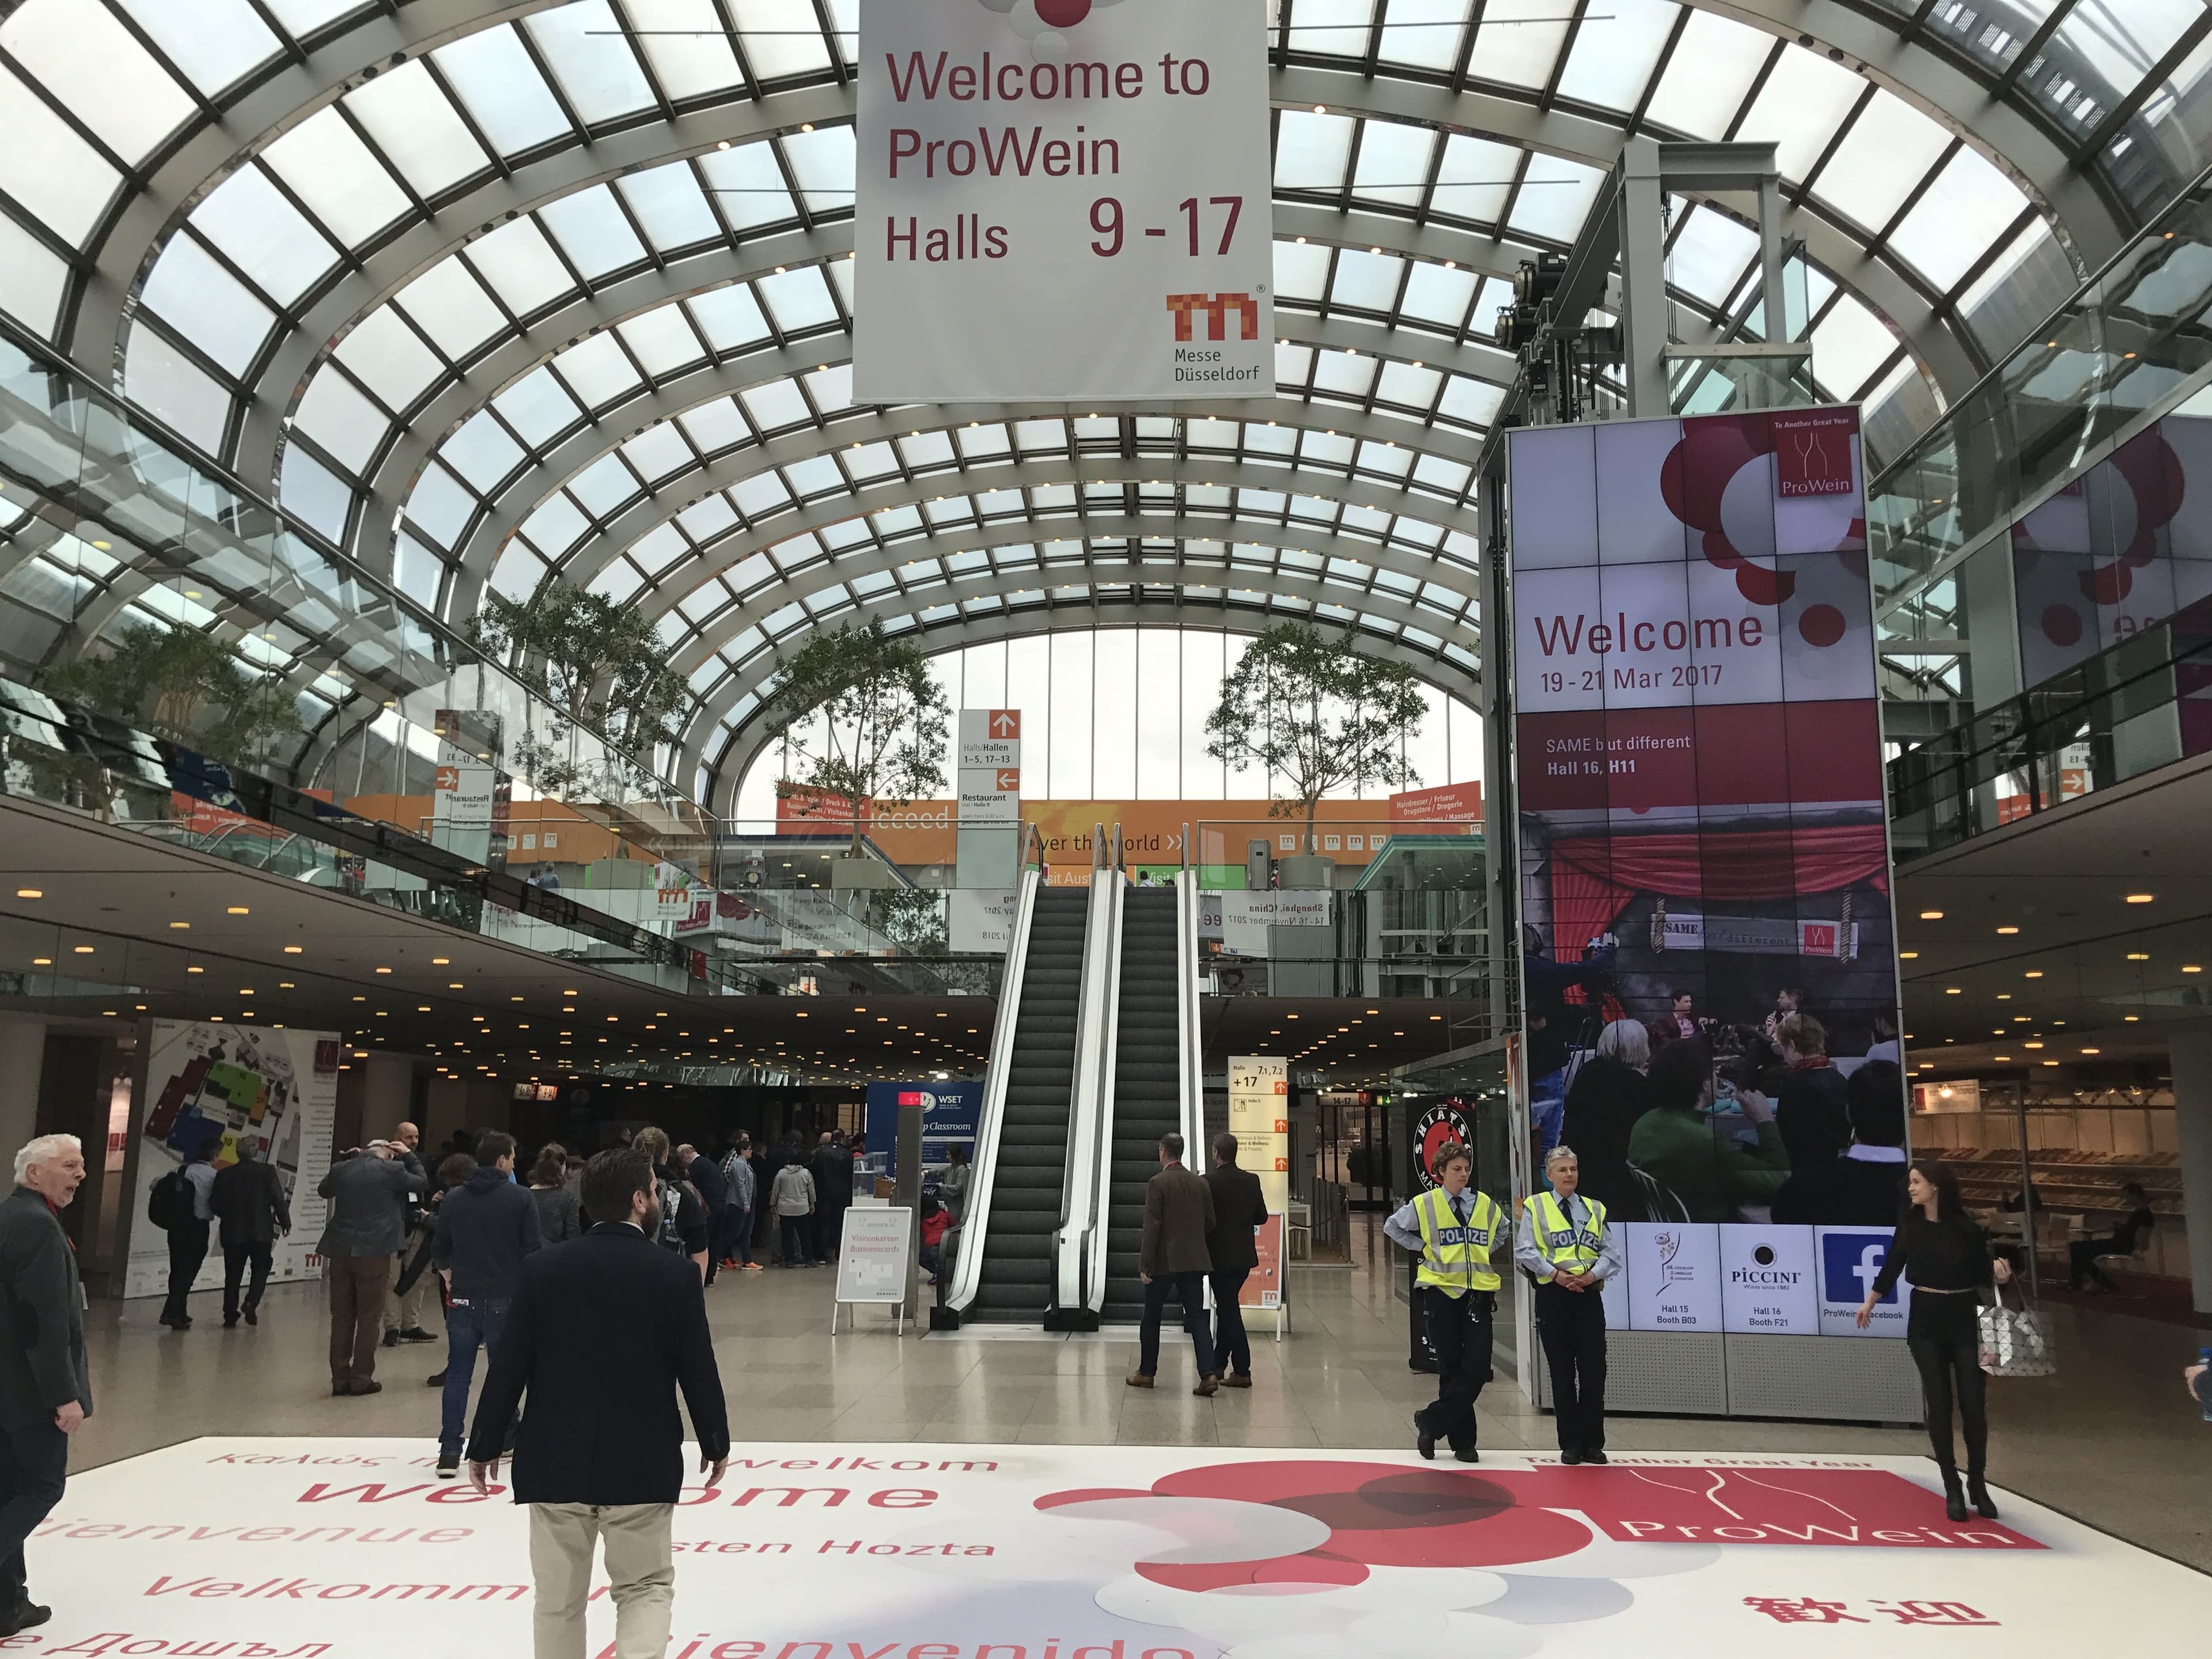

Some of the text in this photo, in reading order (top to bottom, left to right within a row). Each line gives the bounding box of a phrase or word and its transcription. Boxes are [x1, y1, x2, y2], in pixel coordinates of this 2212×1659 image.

[885, 51, 1209, 102] Welcome to
[889, 126, 1119, 179] ProWein
[887, 213, 1008, 261] Halls
[1175, 349, 1221, 362] Messe
[1175, 365, 1259, 381] Düsseldorf
[1783, 478, 1849, 494] ProWein
[1534, 612, 1763, 656] Welcome
[1615, 669, 1662, 690] Mar
[1672, 665, 1722, 687] 2017
[1547, 736, 1691, 753] SAME but different
[1548, 760, 1635, 775] Hall 16, H11
[826, 798, 840, 806] Druck
[1397, 798, 1429, 809] Hairdresser
[1434, 794, 1455, 802] Friseur
[1404, 807, 1431, 816] Drugstore
[1437, 801, 1463, 810] Drogerie
[1449, 812, 1474, 820] Massage
[1036, 838, 1067, 851] ver
[1665, 922, 1698, 934] SAME
[1805, 945, 1833, 954] ProWein
[930, 1122, 971, 1131] Classroom
[1662, 1305, 1677, 1313] Hall
[1754, 1307, 1770, 1315] Hall
[1749, 1318, 1772, 1326] Booth
[1798, 1460, 1874, 1468] Year
[33, 1518, 474, 1544] ienvenue
[1619, 1521, 2016, 1544] ProWein
[671, 1540, 995, 1556] sten Hozta
